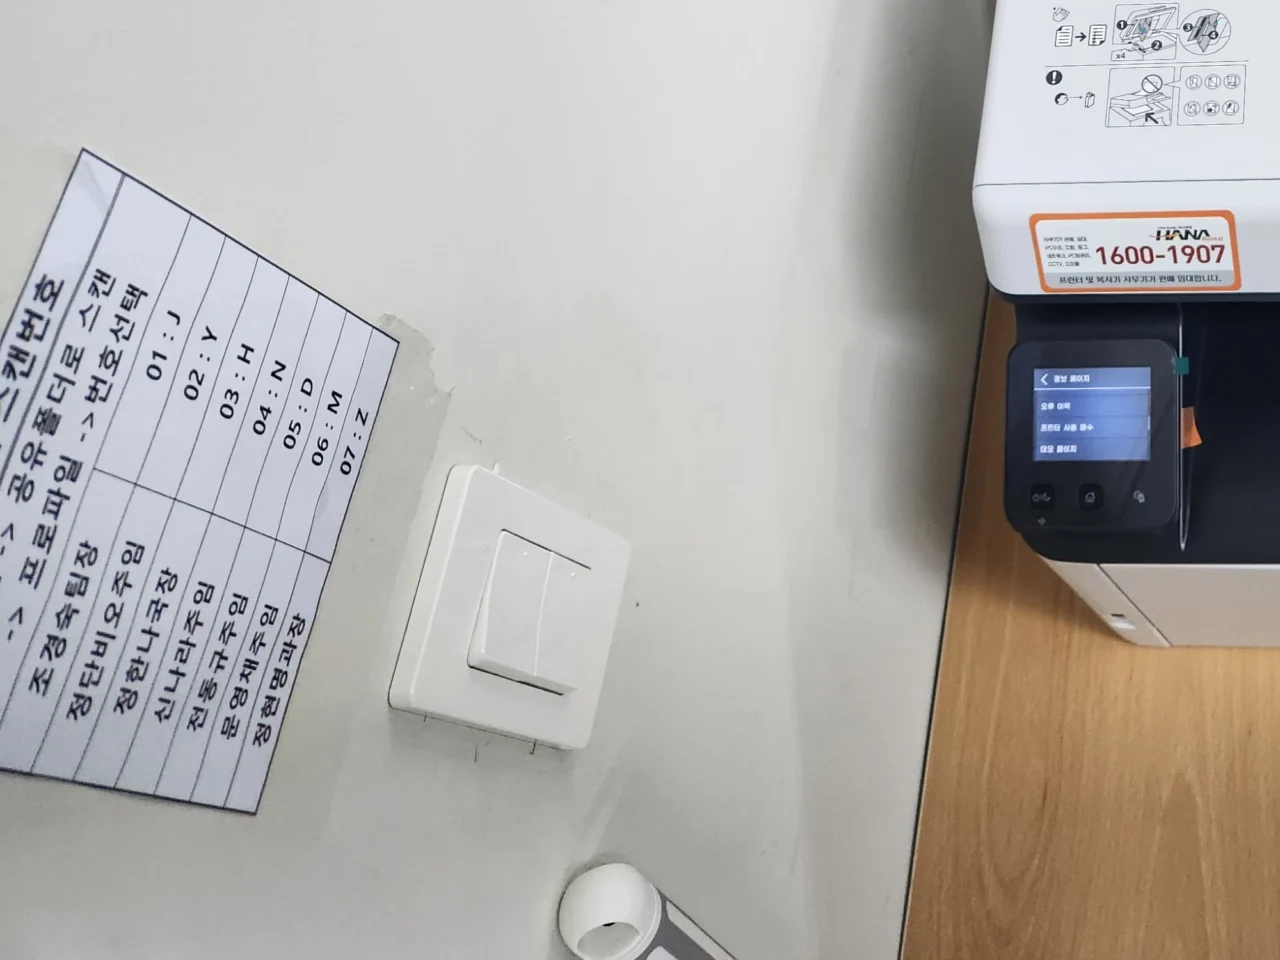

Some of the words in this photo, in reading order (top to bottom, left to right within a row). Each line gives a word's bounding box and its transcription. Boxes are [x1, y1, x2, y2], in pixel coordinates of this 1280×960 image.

[1058, 276, 1084, 284] 프린터
[1096, 245, 1225, 265] 1600-1907
[1156, 229, 1211, 241] HANA
[8, 346, 85, 504] 공유폴더로
[78, 268, 115, 334] 스캔
[19, 455, 84, 591] 프로파일
[29, 541, 100, 698] 조경숙팀장
[146, 351, 168, 382] 01
[167, 311, 182, 327] J
[66, 541, 145, 723] 정단비오주임
[183, 368, 205, 402] 02
[200, 324, 220, 344] Y
[113, 568, 179, 715] 정한나국장
[219, 387, 240, 421] 03
[238, 344, 255, 362] H
[311, 433, 329, 467] 06
[326, 391, 344, 413] M
[154, 581, 214, 724] 신나라주임
[253, 403, 273, 436] 04
[270, 360, 287, 381] N
[187, 593, 249, 734] 전동규주임
[283, 419, 302, 451] 05
[300, 377, 315, 396] D
[252, 614, 307, 748] 정현명과장
[338, 444, 357, 476] 07
[355, 408, 370, 427] Z
